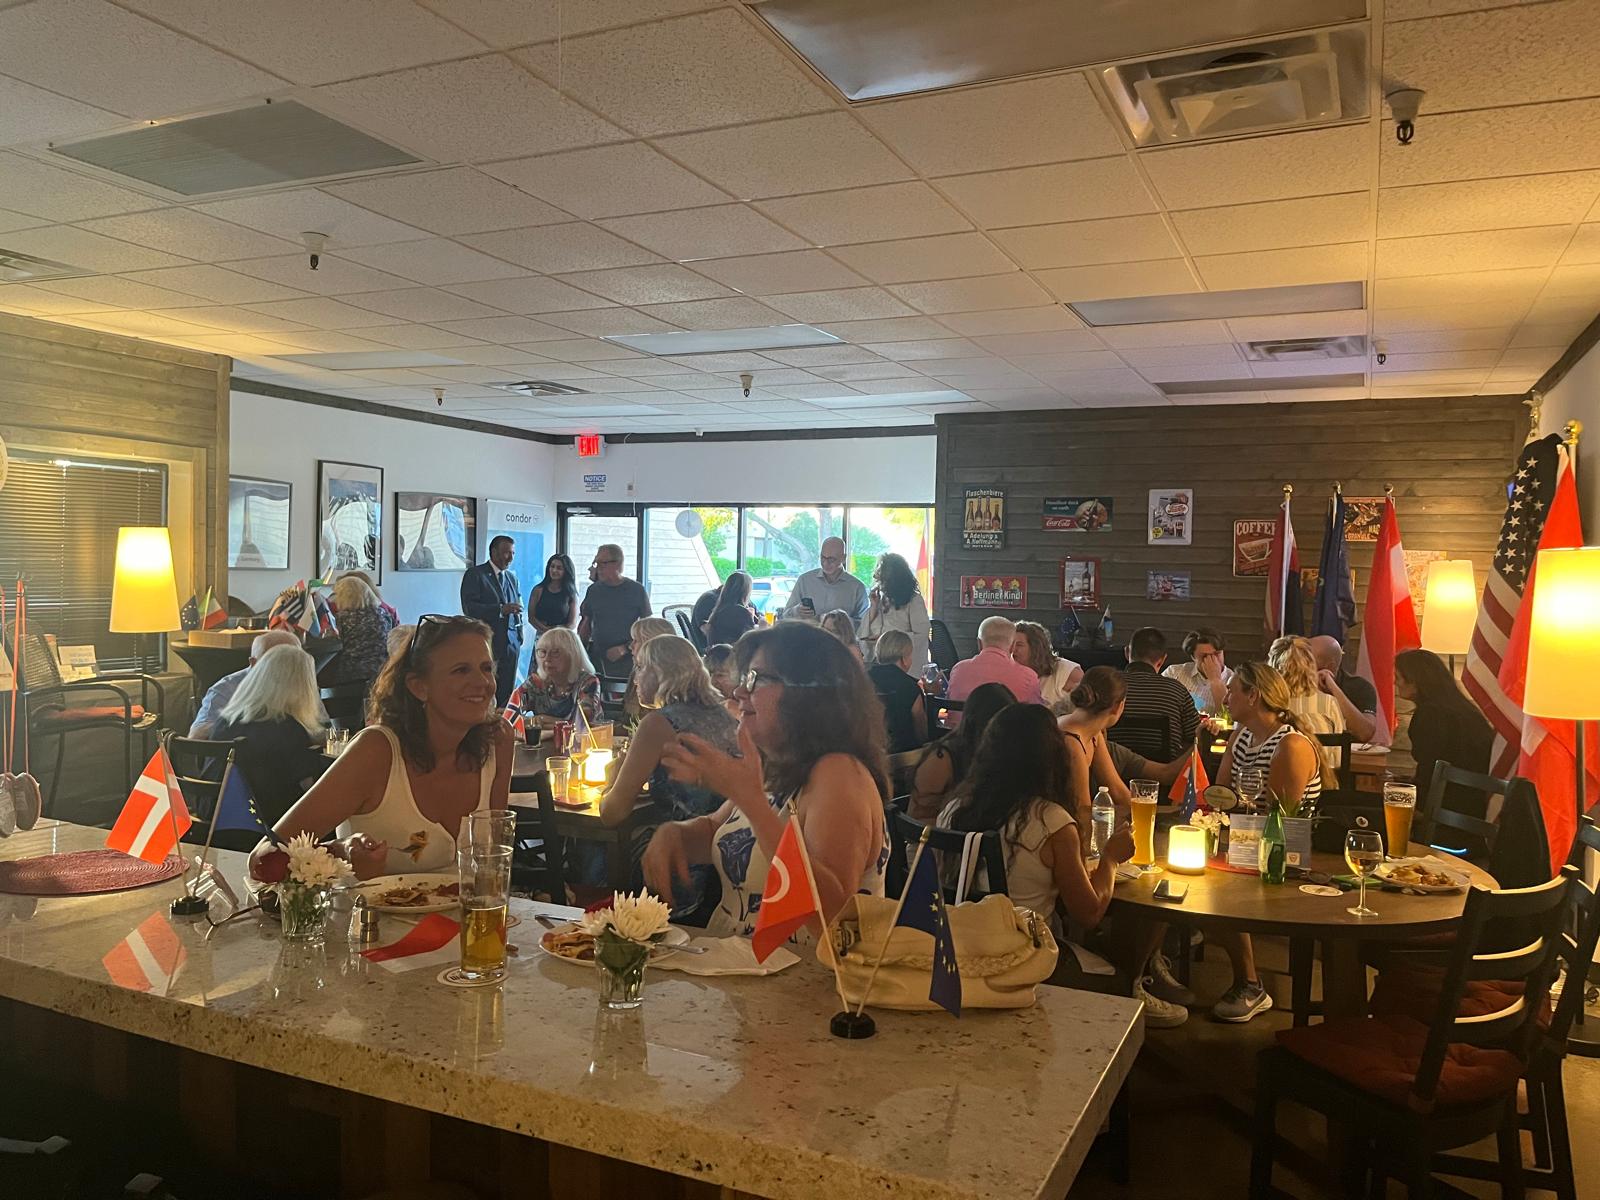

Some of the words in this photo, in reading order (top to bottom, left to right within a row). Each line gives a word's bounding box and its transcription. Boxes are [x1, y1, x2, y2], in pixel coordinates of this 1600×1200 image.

[579, 436, 599, 456] EXIT
[505, 513, 532, 523] condor
[973, 590, 1003, 599] Berliner
[1003, 591, 1023, 600] Kindl
